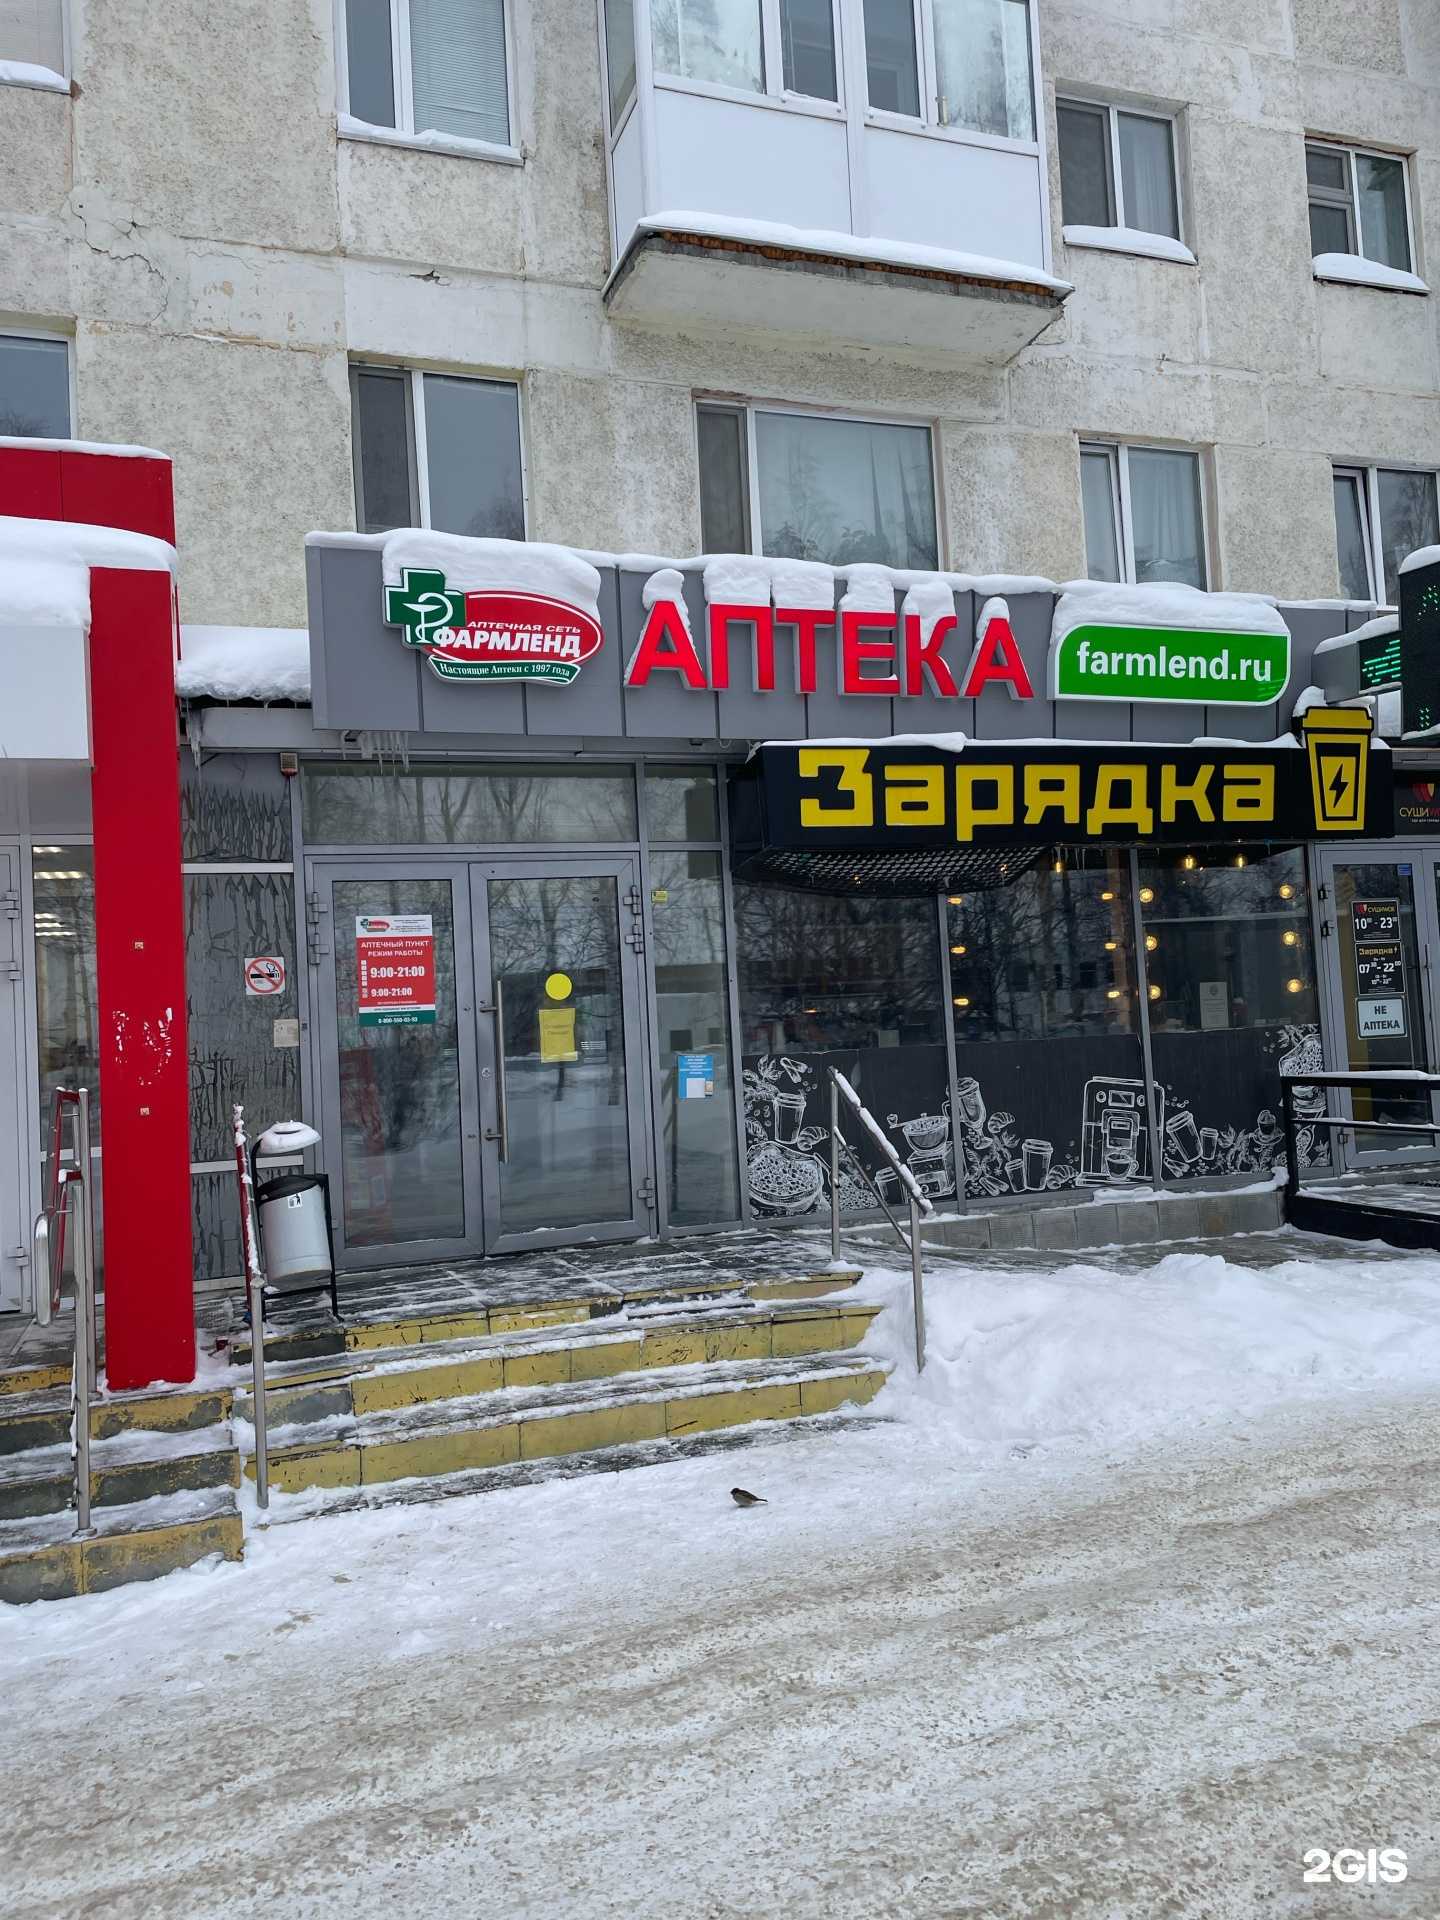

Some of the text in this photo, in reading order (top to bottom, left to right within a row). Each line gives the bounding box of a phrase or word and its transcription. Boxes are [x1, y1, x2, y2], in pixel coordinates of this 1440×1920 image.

[467, 621, 581, 633] АПТЕЧНАЯ СЕТЬ
[432, 626, 581, 658] ФАРМЛЕНД
[625, 600, 1034, 699] АПТЕКА
[1077, 641, 1272, 682] farmlend.ru
[439, 663, 489, 675] Настоящие
[490, 665, 522, 674] Аптеки
[531, 664, 550, 672] 1997
[551, 665, 570, 677] года
[799, 748, 1276, 841] Зарядка
[361, 940, 403, 948] АПТЕЧНЫЙ
[370, 966, 425, 978] 9:00-21:00
[370, 987, 413, 997] 9:00-21:00
[1374, 1005, 1387, 1015] НЕ
[1363, 1018, 1400, 1031] АПТЕКА
